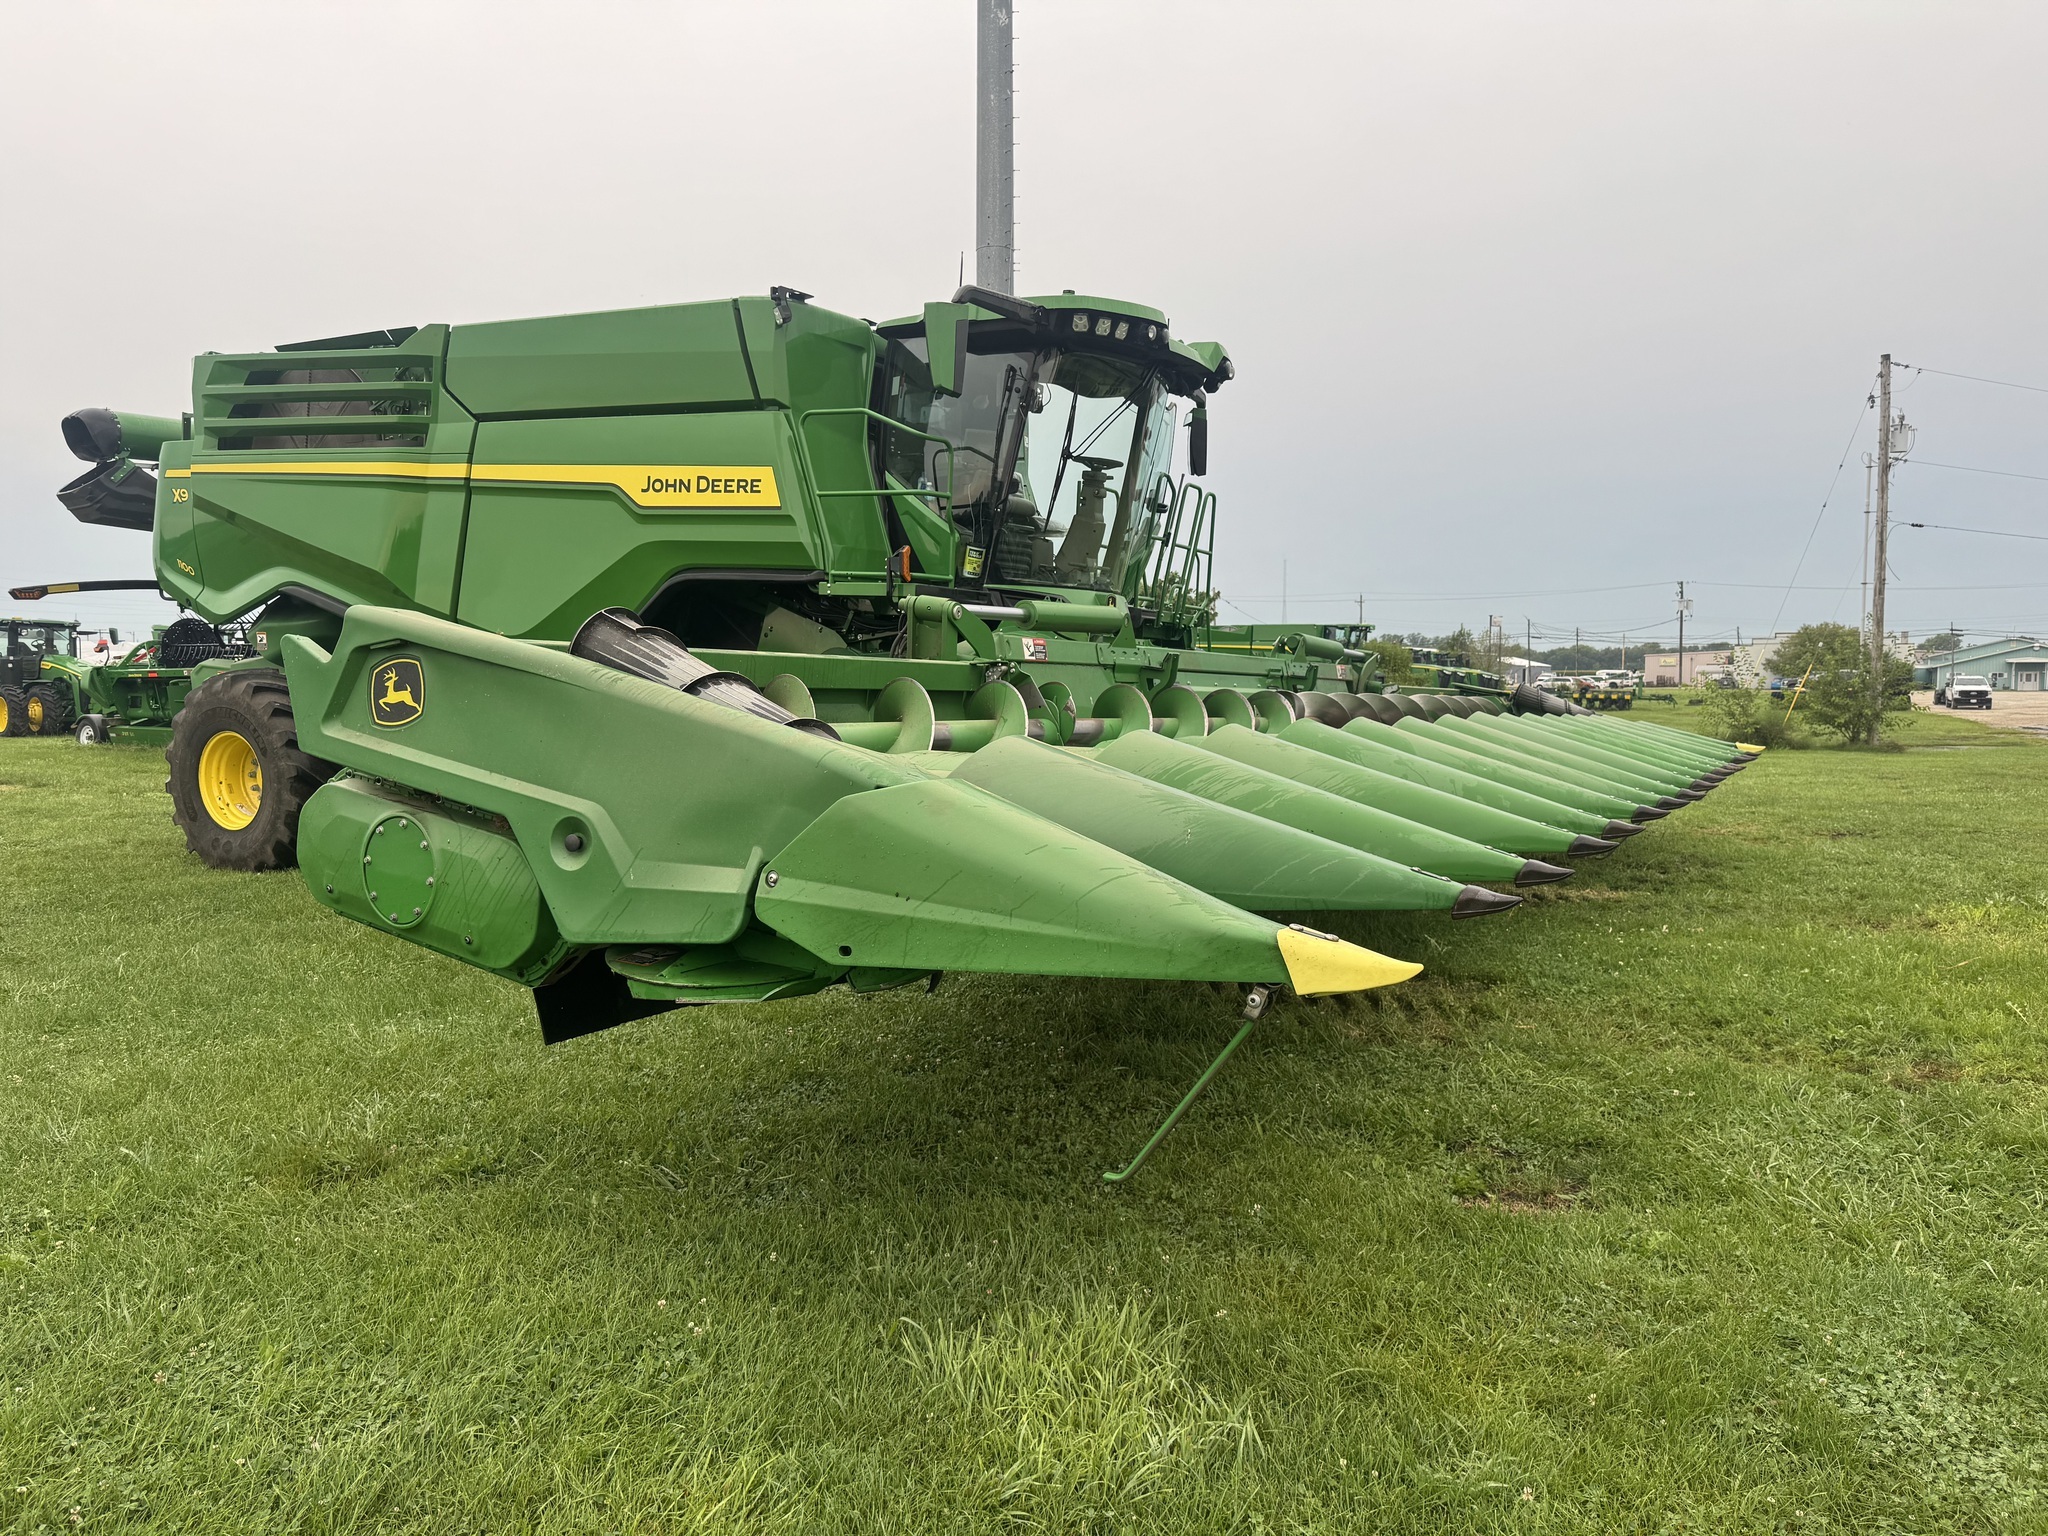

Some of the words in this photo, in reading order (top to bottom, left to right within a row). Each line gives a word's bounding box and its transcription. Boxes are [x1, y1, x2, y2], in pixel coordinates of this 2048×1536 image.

[641, 475, 691, 493] JOHN
[696, 475, 762, 494] DEERE
[171, 488, 189, 503] X9
[176, 558, 196, 576] 1100
